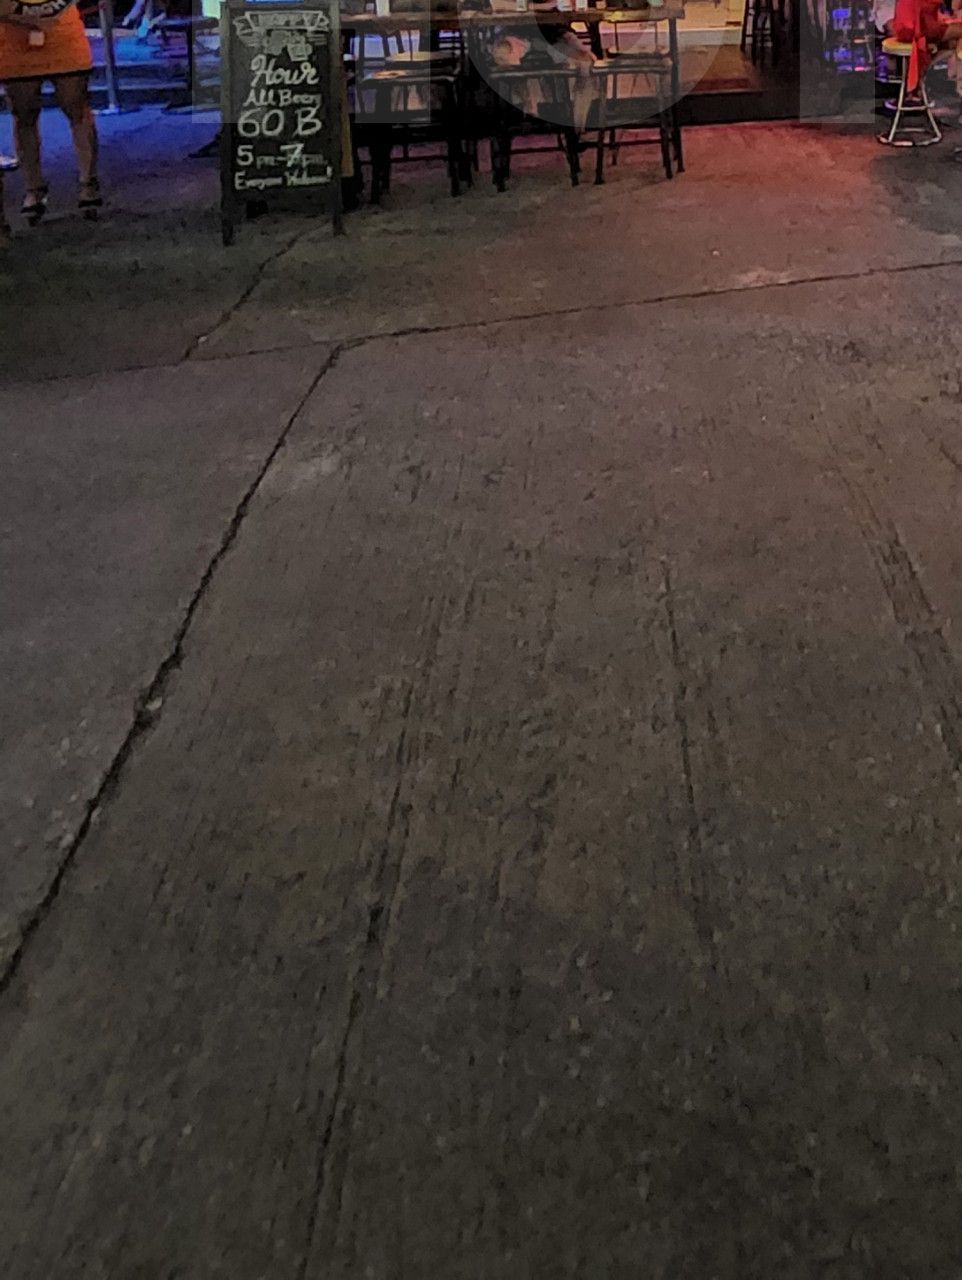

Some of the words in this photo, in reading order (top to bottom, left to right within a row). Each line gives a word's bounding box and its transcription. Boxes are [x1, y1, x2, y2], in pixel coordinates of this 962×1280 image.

[250, 53, 320, 88] Hour
[243, 88, 276, 107] All
[237, 107, 286, 138] 60
[293, 106, 323, 138] B
